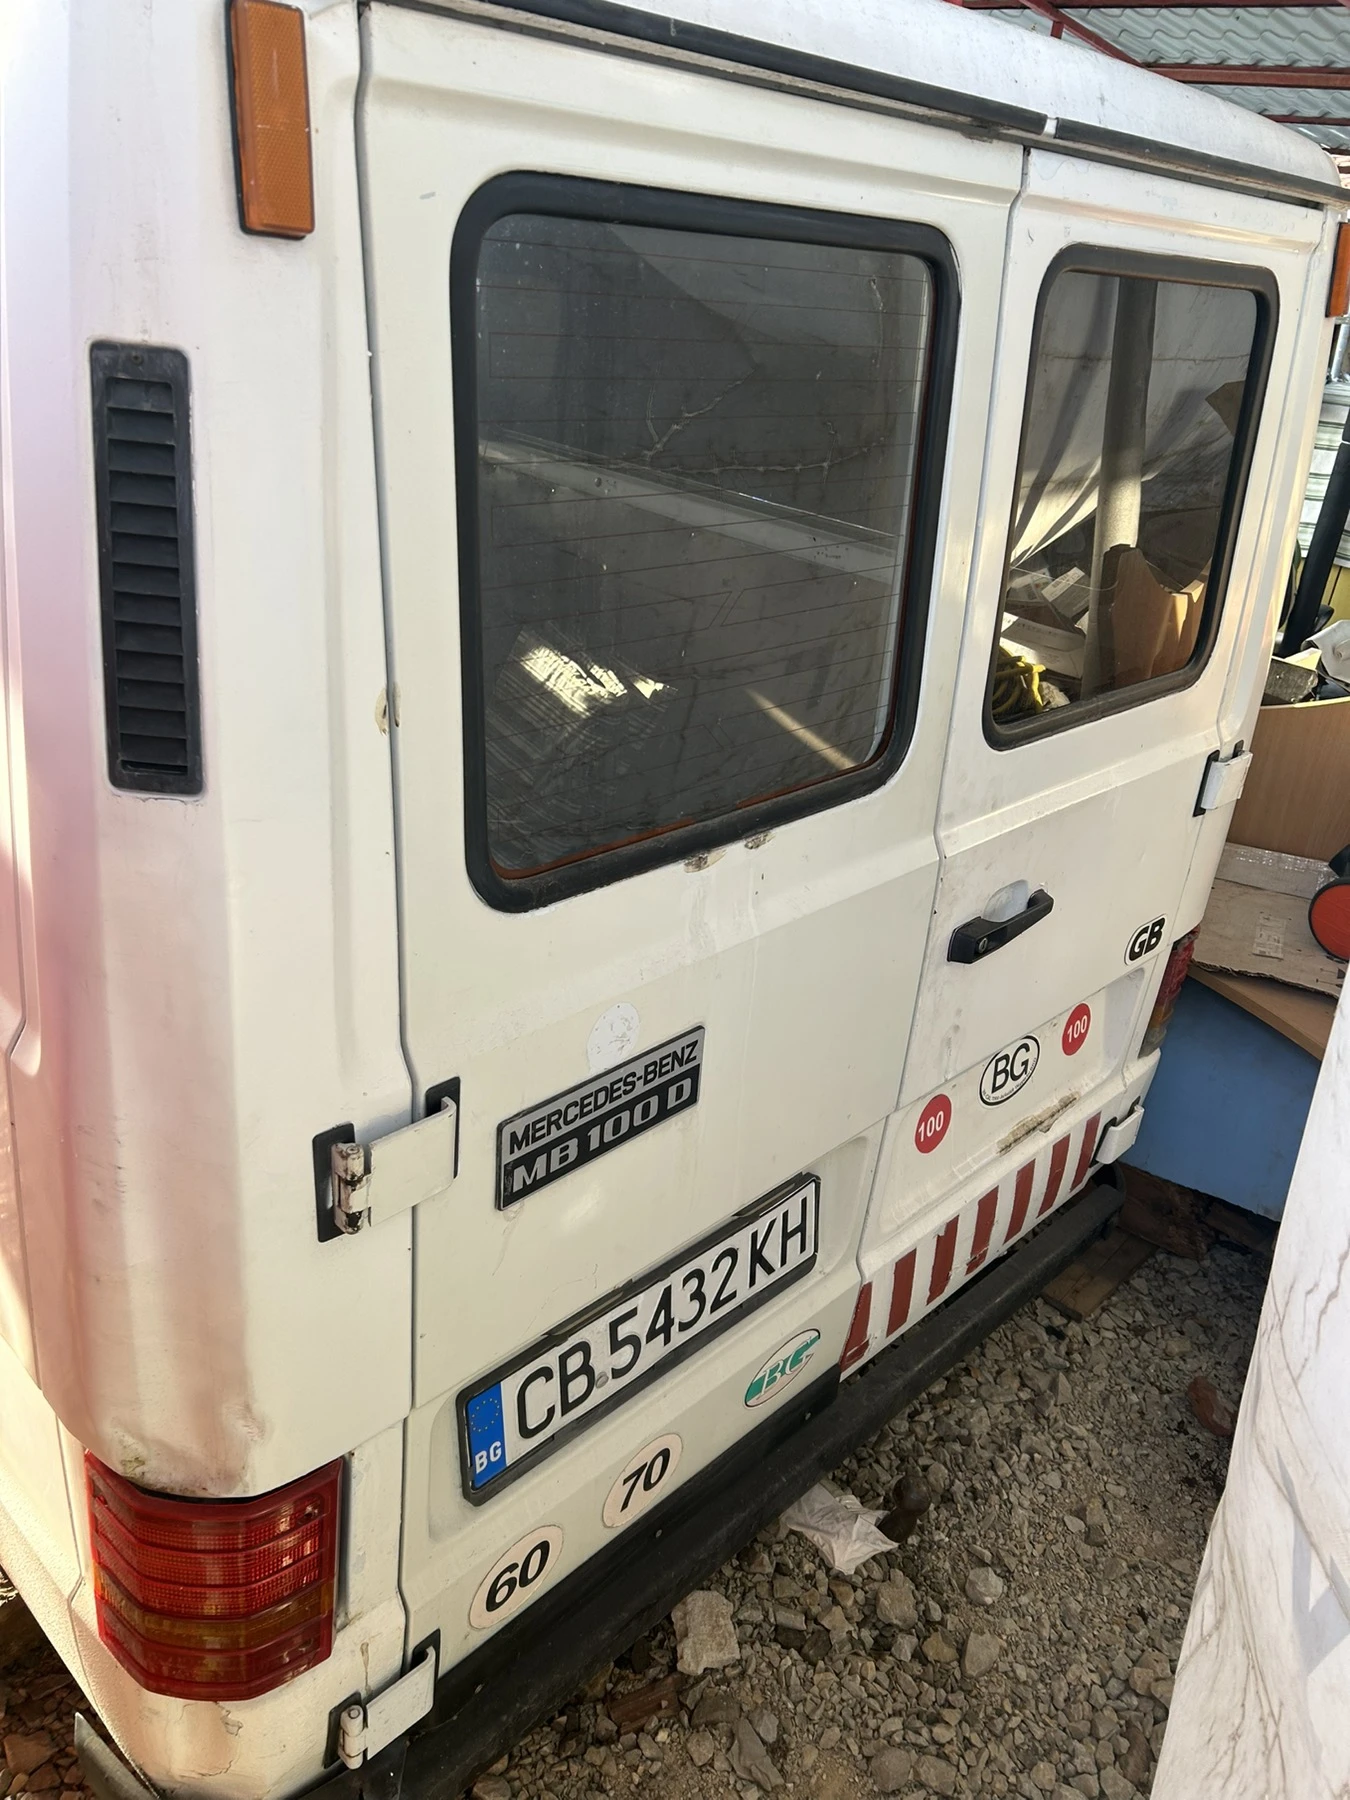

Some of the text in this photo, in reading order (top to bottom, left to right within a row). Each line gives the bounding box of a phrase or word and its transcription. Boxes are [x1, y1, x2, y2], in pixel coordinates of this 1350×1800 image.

[1129, 917, 1166, 962] GB
[1067, 1014, 1088, 1043] 100
[992, 1042, 1030, 1094] BG
[509, 1039, 700, 1155] MERCEDES-BENZ
[513, 1076, 692, 1193] MB 100 D
[918, 1110, 944, 1142] 100
[475, 1441, 502, 1474] BG
[620, 1447, 671, 1513] 70
[485, 1540, 551, 1613] 60
